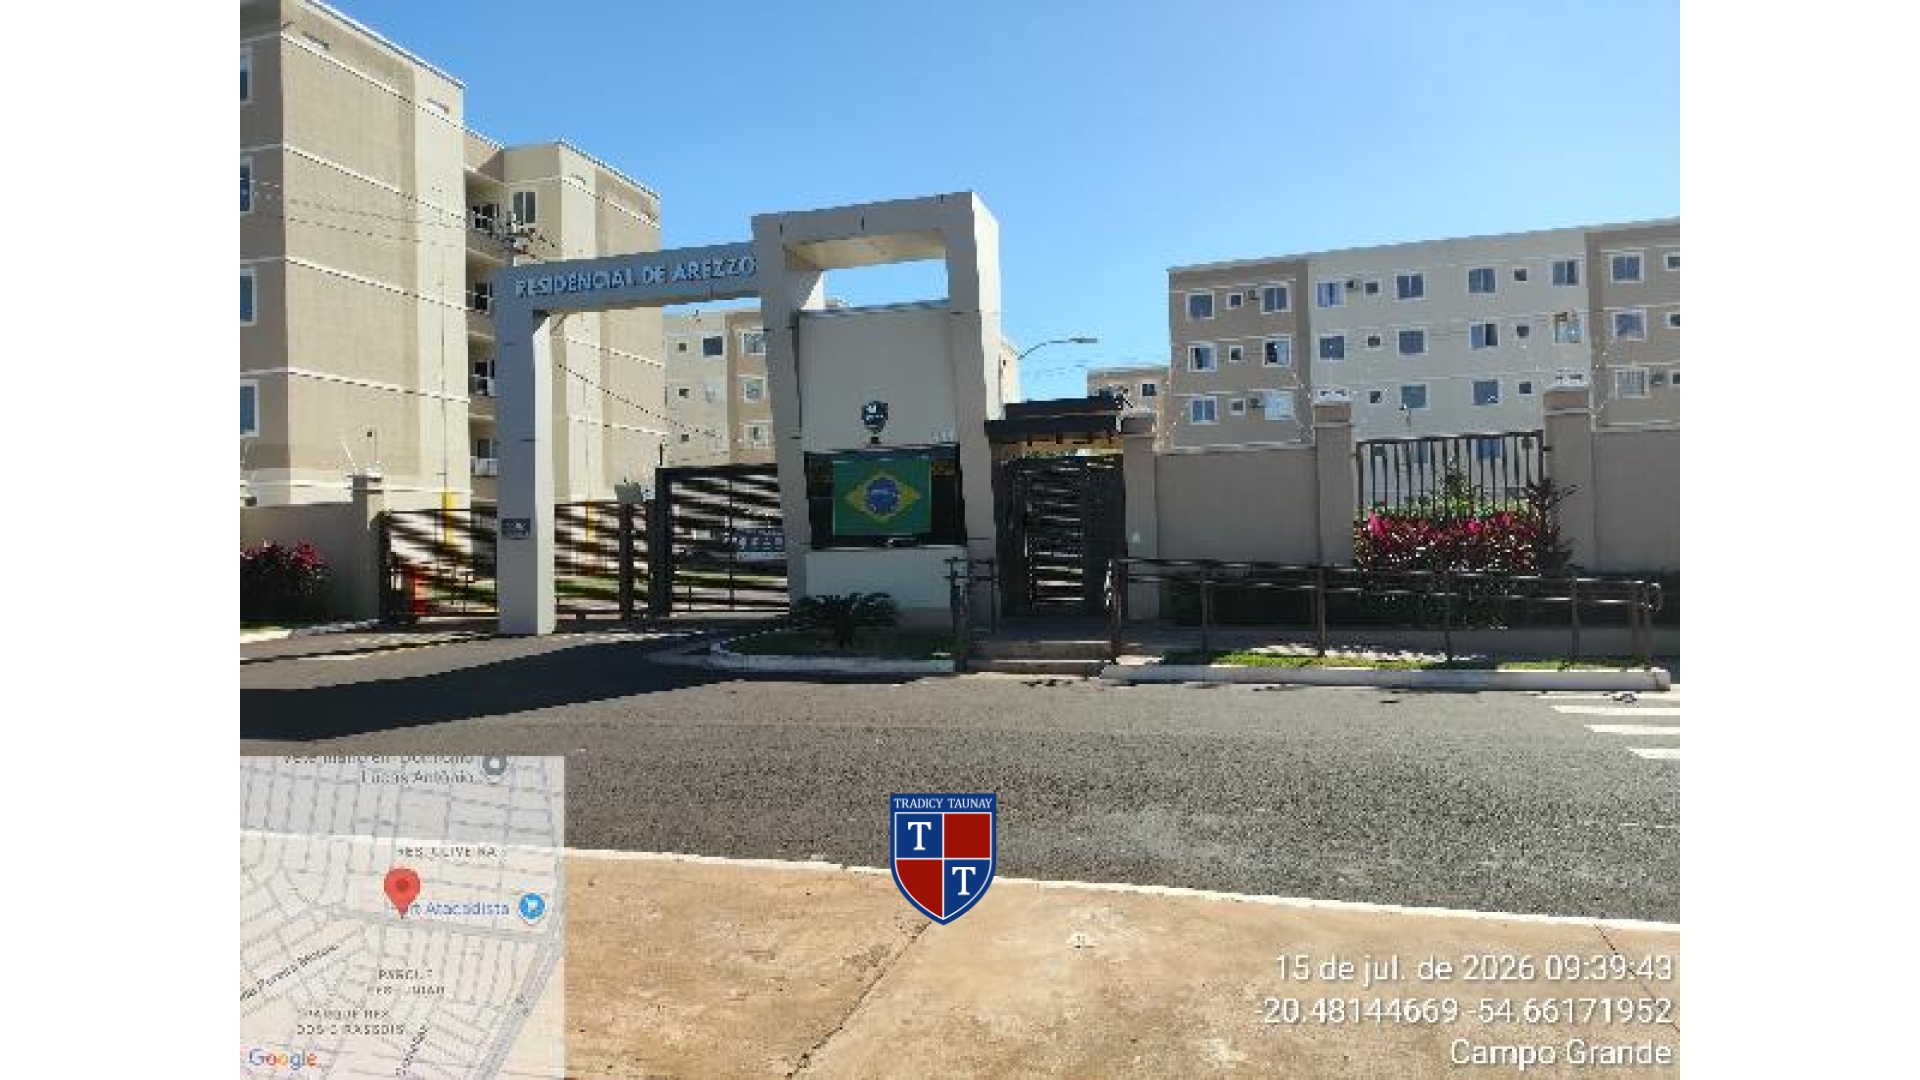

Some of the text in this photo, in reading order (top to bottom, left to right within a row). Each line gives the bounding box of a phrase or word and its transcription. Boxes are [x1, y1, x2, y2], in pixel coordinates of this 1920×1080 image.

[515, 256, 758, 298] RESIDENCIAL DE AREZZO
